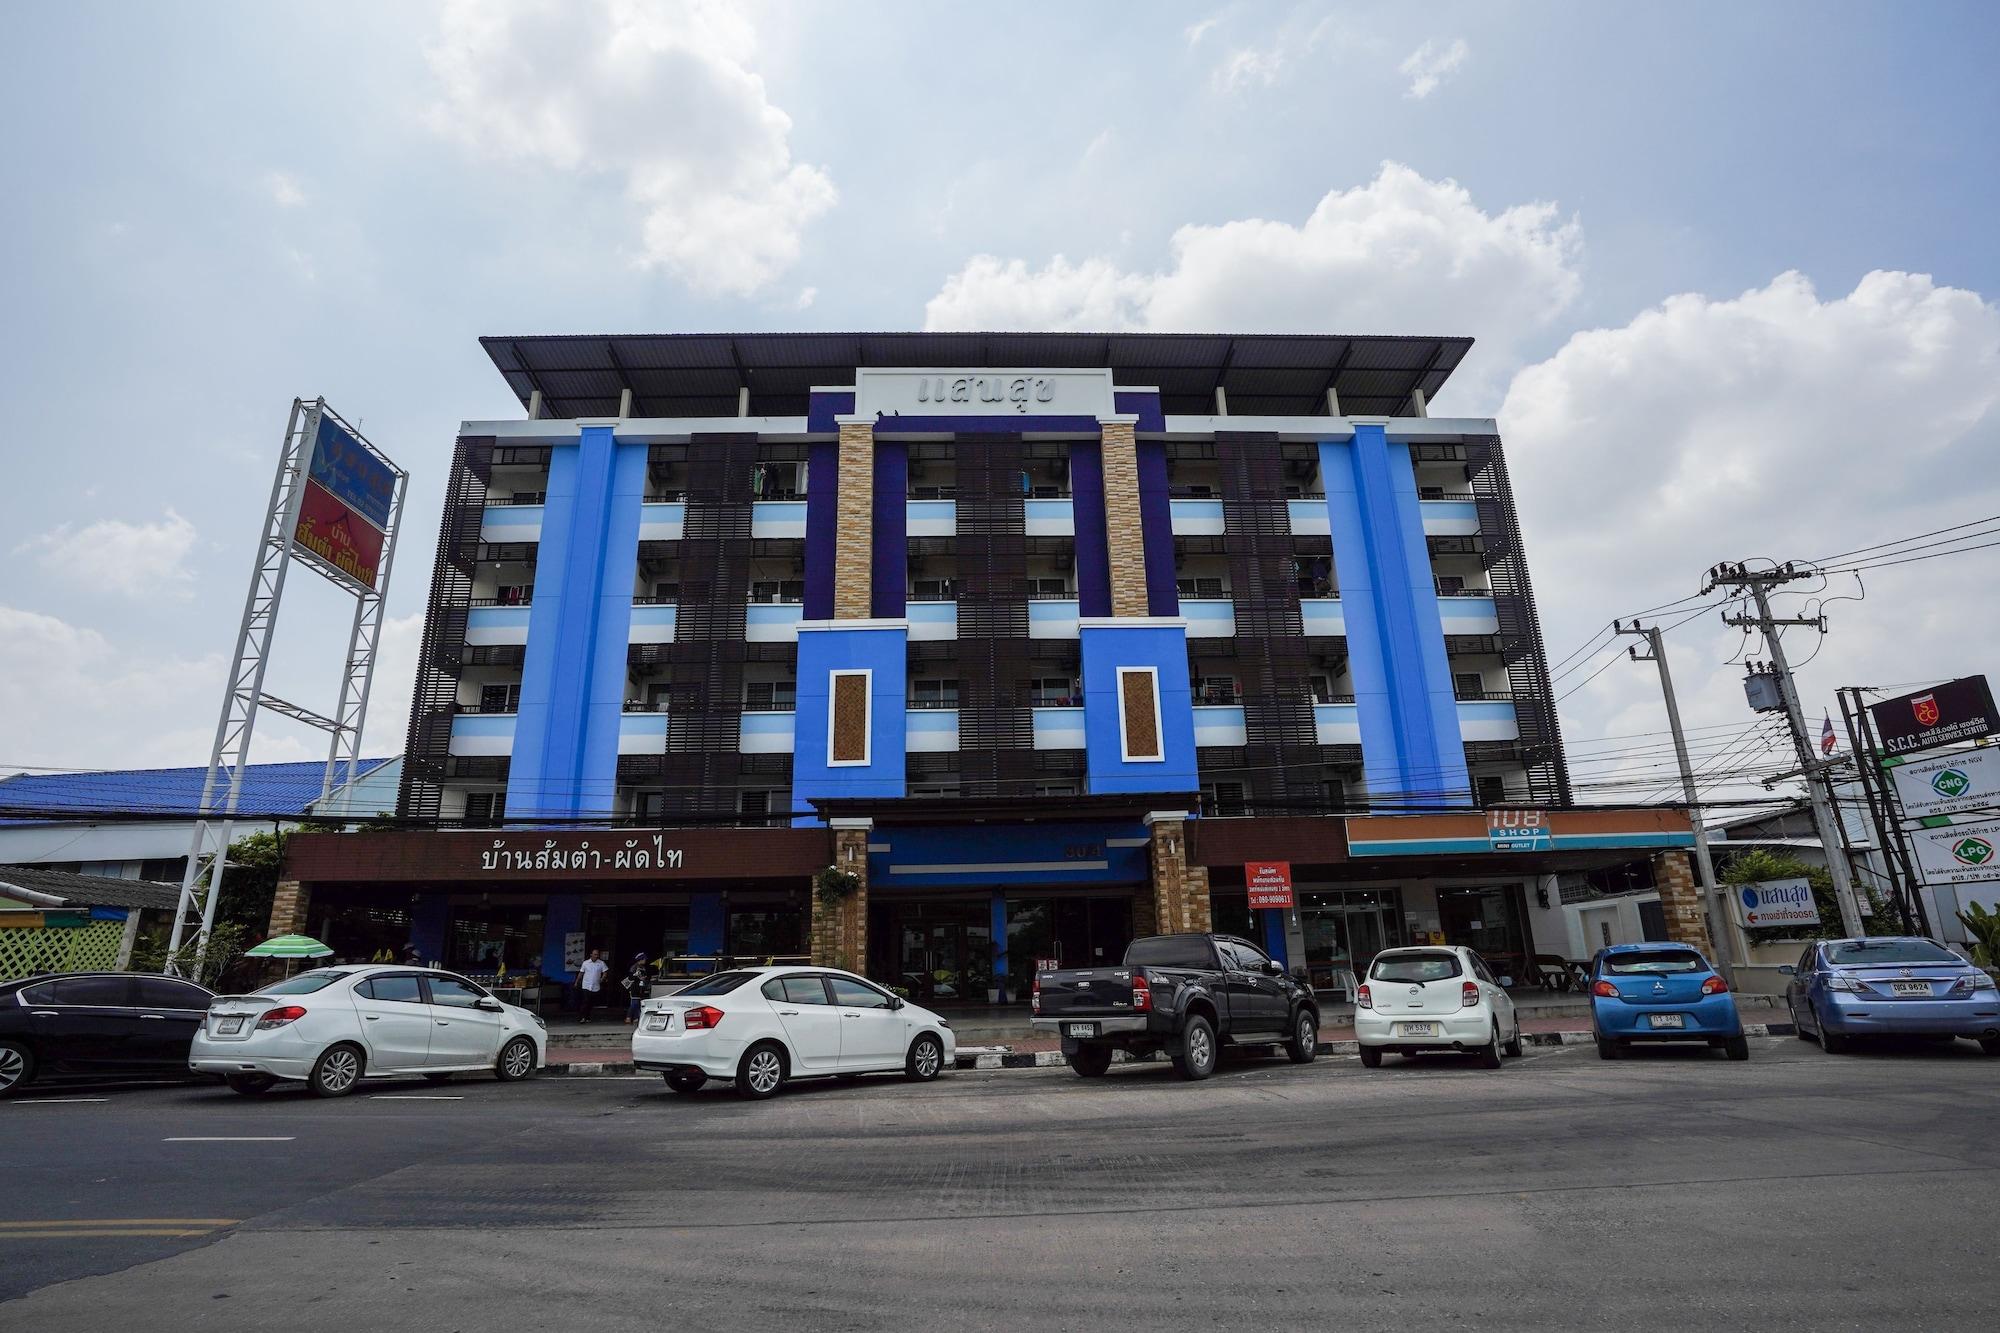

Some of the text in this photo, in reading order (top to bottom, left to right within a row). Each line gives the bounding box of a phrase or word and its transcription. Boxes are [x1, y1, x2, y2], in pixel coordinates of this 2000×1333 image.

[918, 377, 1056, 414] แสนสุข
[331, 523, 351, 548] บ้าน
[1887, 734, 1921, 753] S.C.C.
[1921, 723, 1989, 747] AUTO SERVICE CENTER
[1938, 777, 1963, 789] CNG
[1499, 828, 1540, 837] SHOP
[481, 834, 683, 871] บ้านส้มตำ-ผัดไท
[1959, 845, 1987, 857] LPG
[1760, 885, 1808, 908] แสนสุข
